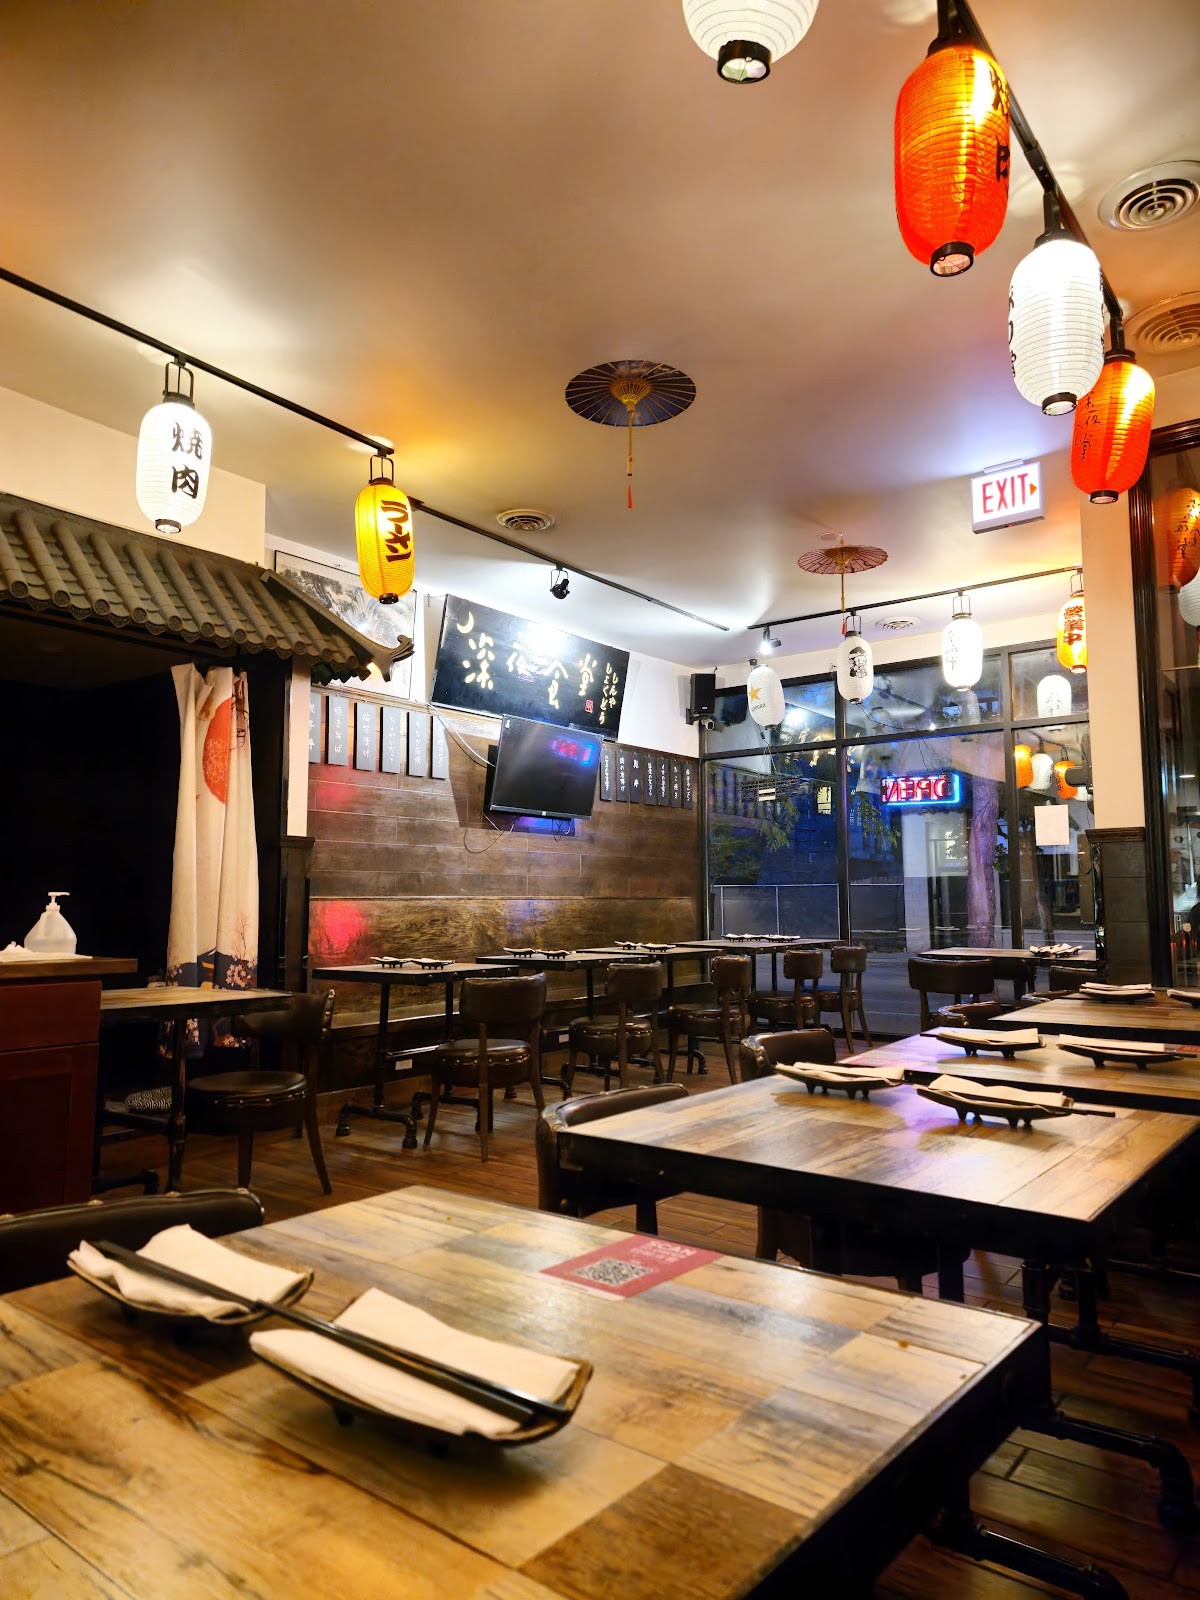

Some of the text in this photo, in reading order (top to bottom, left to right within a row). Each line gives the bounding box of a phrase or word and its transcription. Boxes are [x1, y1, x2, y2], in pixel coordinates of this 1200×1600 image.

[171, 421, 204, 499] 焼肉
[982, 472, 1029, 514] EXIT
[380, 499, 412, 563] ラーメン
[333, 705, 344, 753] 焼きそば
